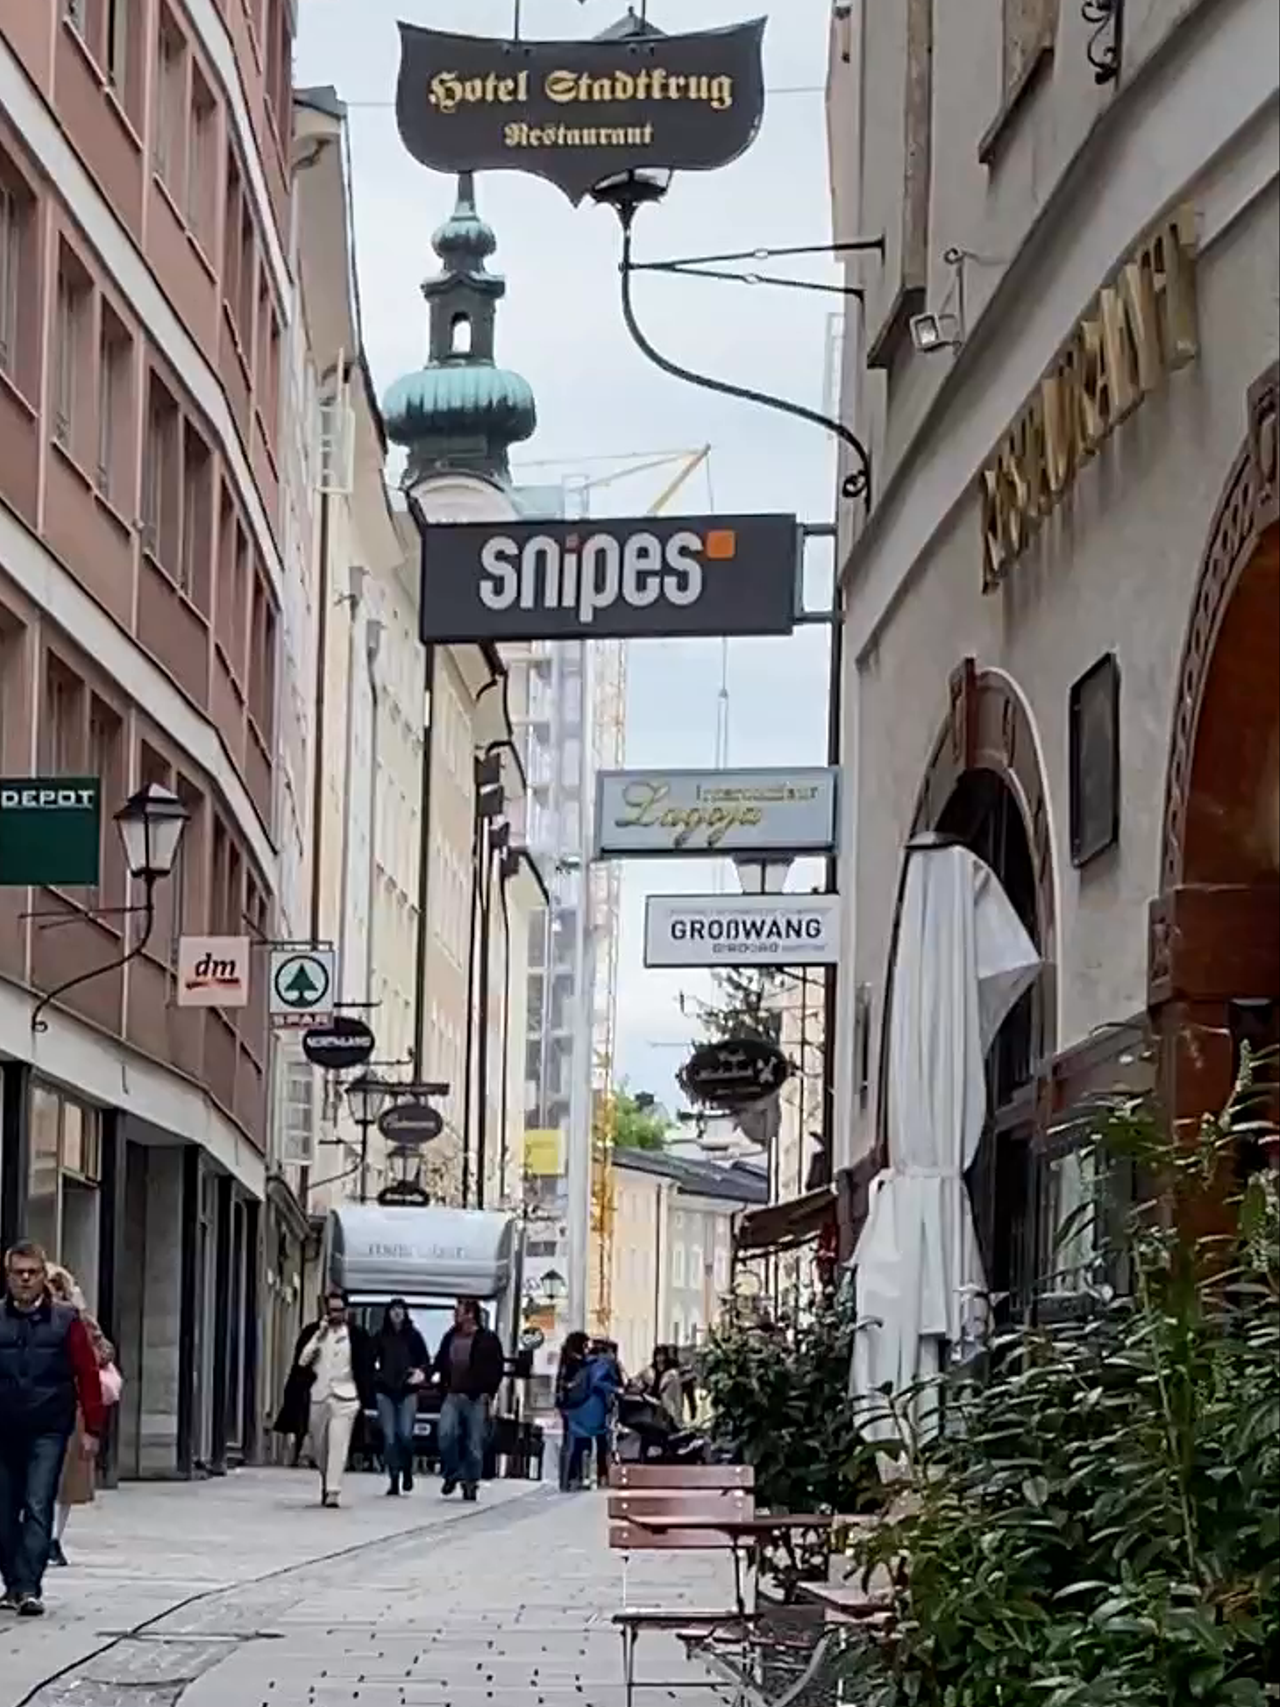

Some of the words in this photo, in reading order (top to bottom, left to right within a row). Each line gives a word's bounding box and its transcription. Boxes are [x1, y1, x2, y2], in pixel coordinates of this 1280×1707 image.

[427, 69, 529, 115] Hotel
[544, 66, 734, 110] Stadtkrug
[503, 121, 655, 148] Restaurant
[478, 531, 705, 625] snipes
[1, 789, 96, 810] DEPOT
[195, 952, 237, 978] dm
